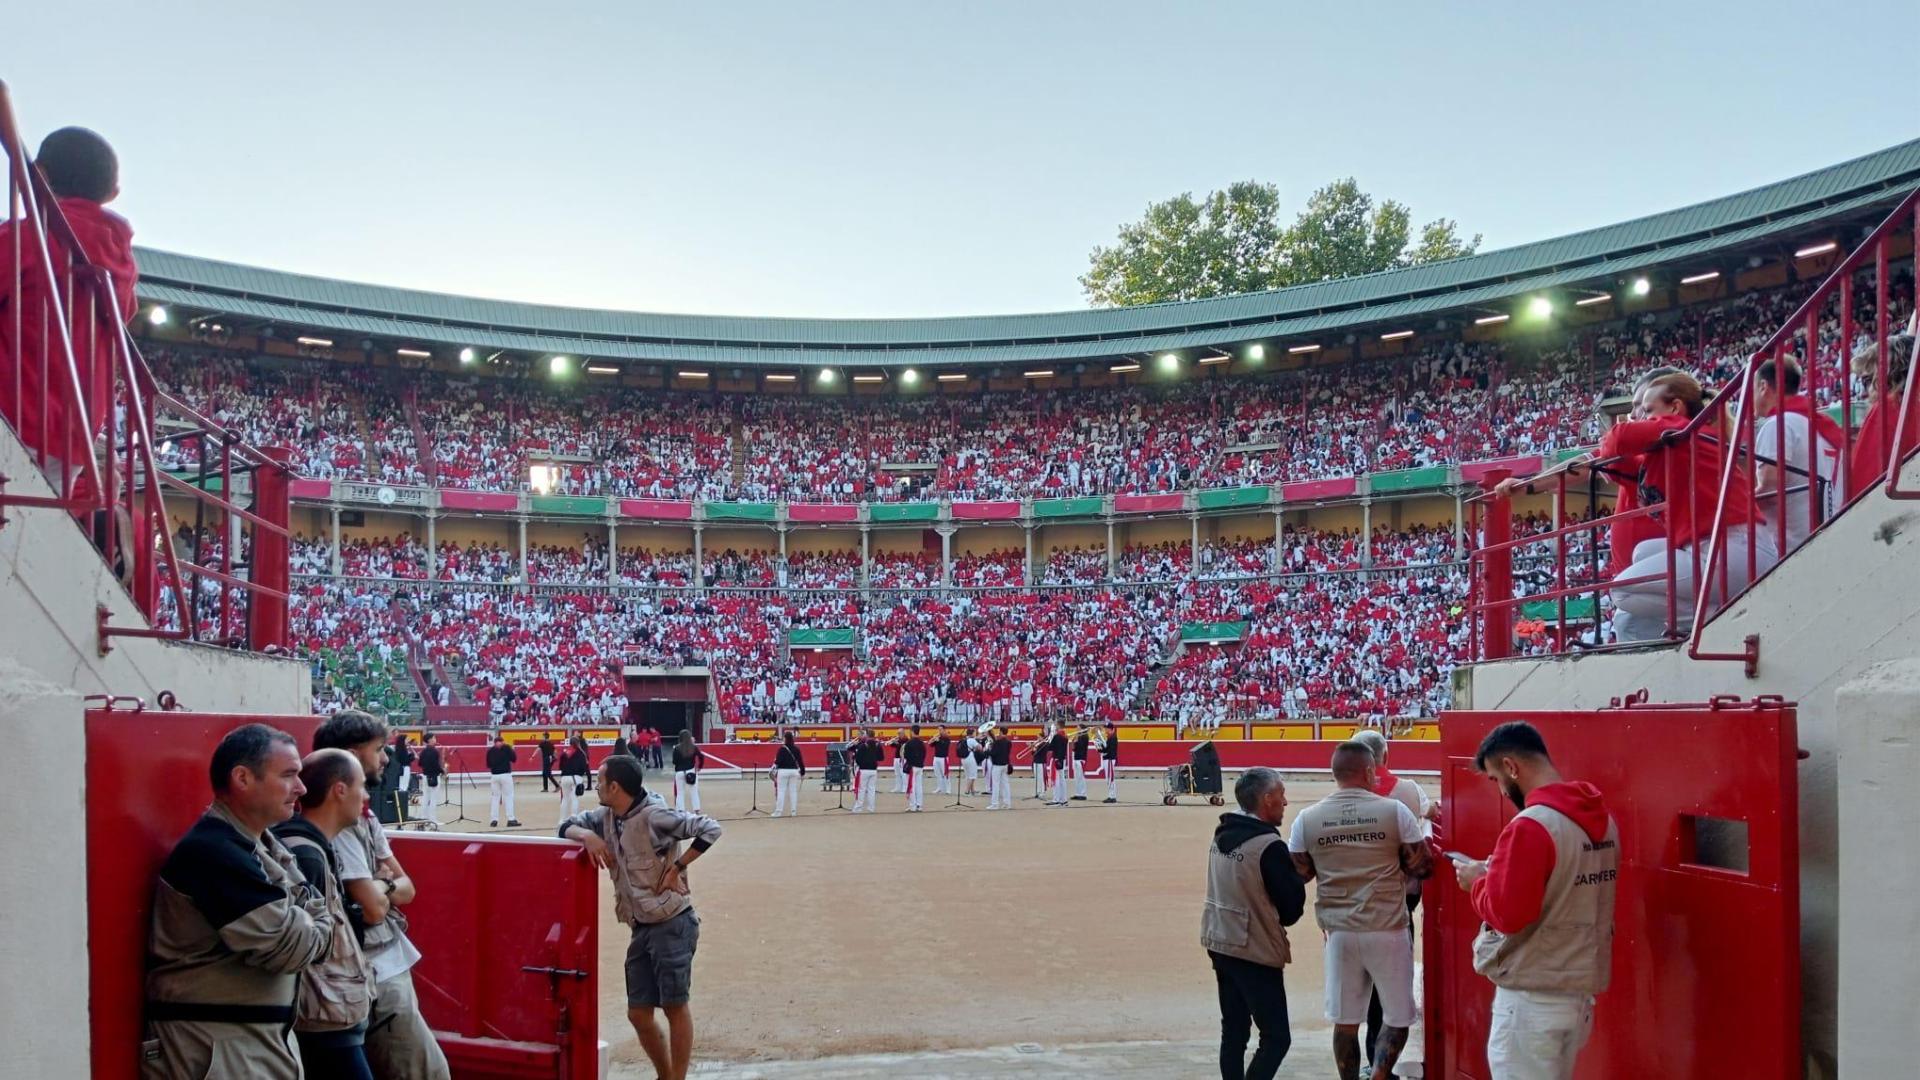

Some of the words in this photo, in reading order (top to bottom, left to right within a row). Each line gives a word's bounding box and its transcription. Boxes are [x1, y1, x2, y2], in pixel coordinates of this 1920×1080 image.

[1142, 729, 1148, 739] 7
[1279, 728, 1286, 738] 7
[1419, 727, 1427, 738] 7
[1318, 832, 1386, 846] CARPINTERO
